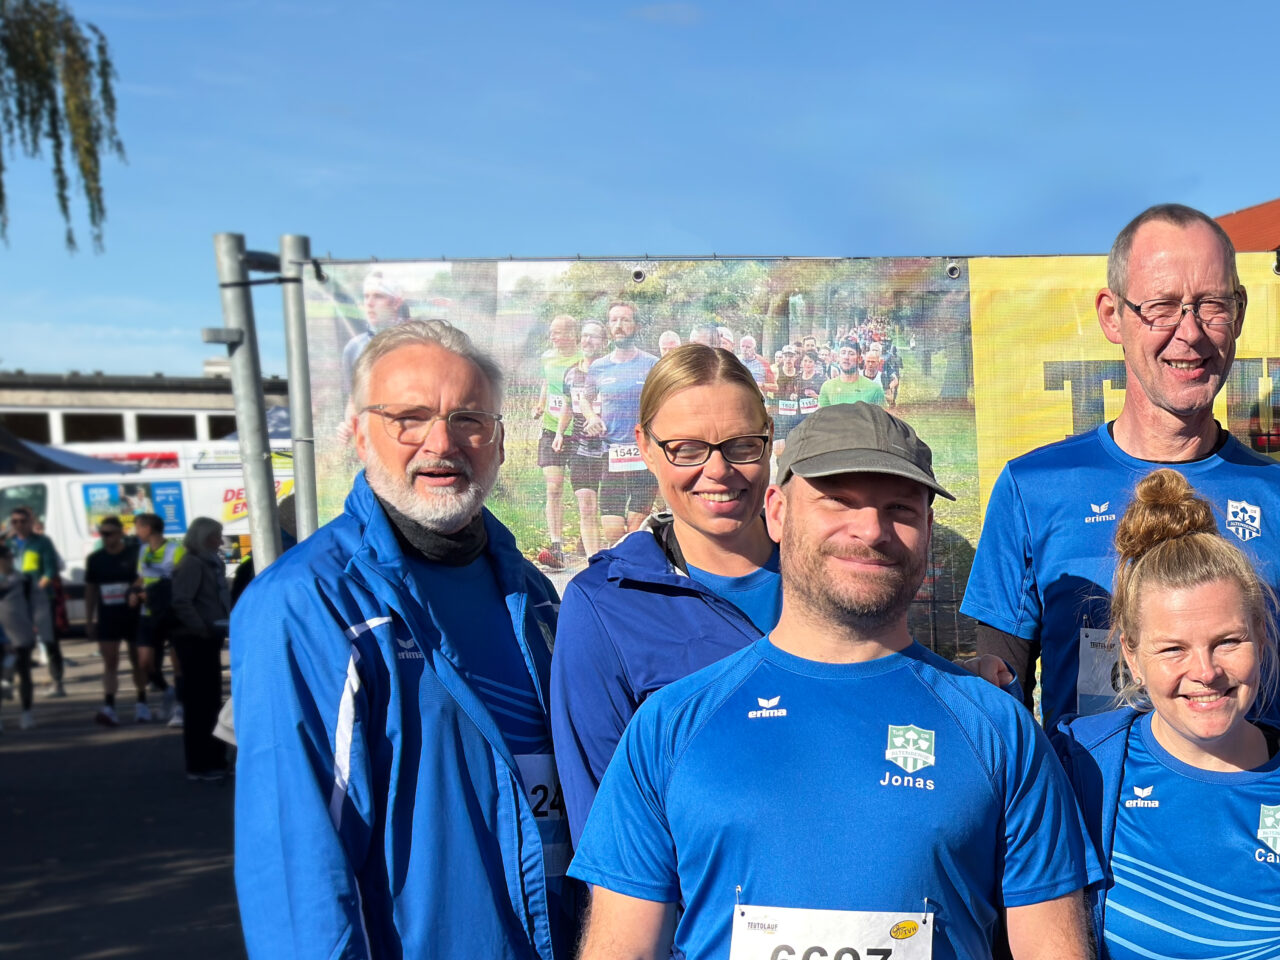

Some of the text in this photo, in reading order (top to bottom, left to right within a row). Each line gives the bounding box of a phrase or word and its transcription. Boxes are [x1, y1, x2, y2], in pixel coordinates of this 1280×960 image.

[615, 448, 639, 457] 1542
[1085, 513, 1116, 523] erima
[748, 708, 787, 718] erima
[880, 772, 935, 790] Jonas
[1125, 799, 1159, 808] erima
